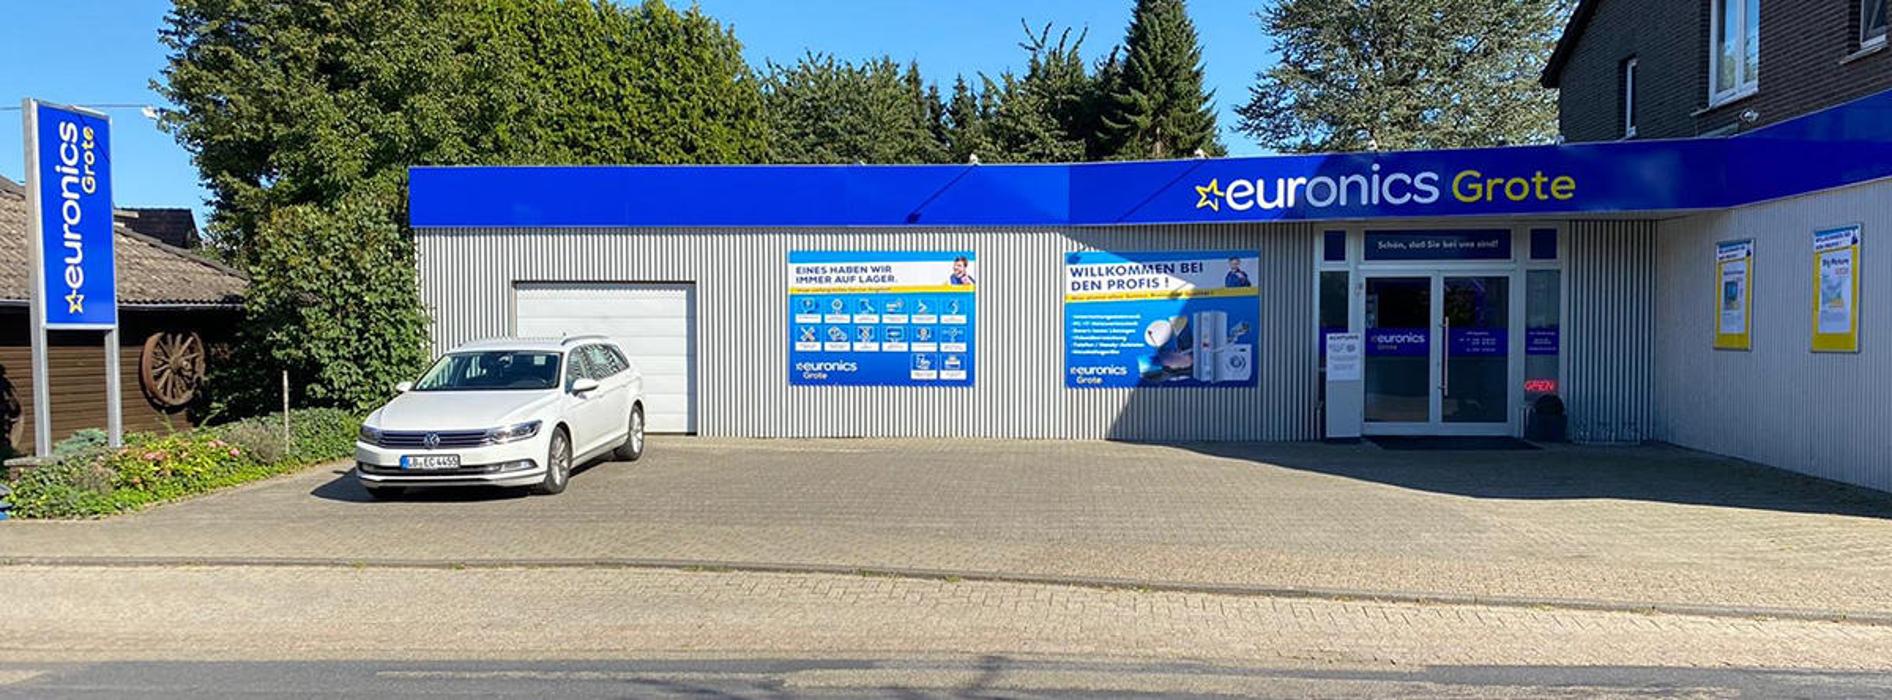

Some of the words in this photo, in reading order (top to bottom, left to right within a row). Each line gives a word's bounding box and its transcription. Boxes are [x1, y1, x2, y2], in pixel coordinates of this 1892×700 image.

[81, 126, 97, 194] Grote
[1226, 163, 1440, 211] euronics
[1451, 169, 1577, 203] Grote
[54, 121, 84, 289] euronics
[795, 266, 828, 275] EINES
[830, 266, 868, 275] HABEN
[870, 265, 892, 274] WIR
[1070, 262, 1175, 278] WILLKOMMEN
[1180, 262, 1204, 273] BEI
[795, 275, 832, 284] IMMER
[834, 275, 857, 284] AUF
[1071, 279, 1105, 292] DEN
[1107, 277, 1160, 290] PROFIS
[1377, 331, 1426, 344] euronics
[803, 360, 858, 373] euronics
[1076, 363, 1127, 376] euronics
